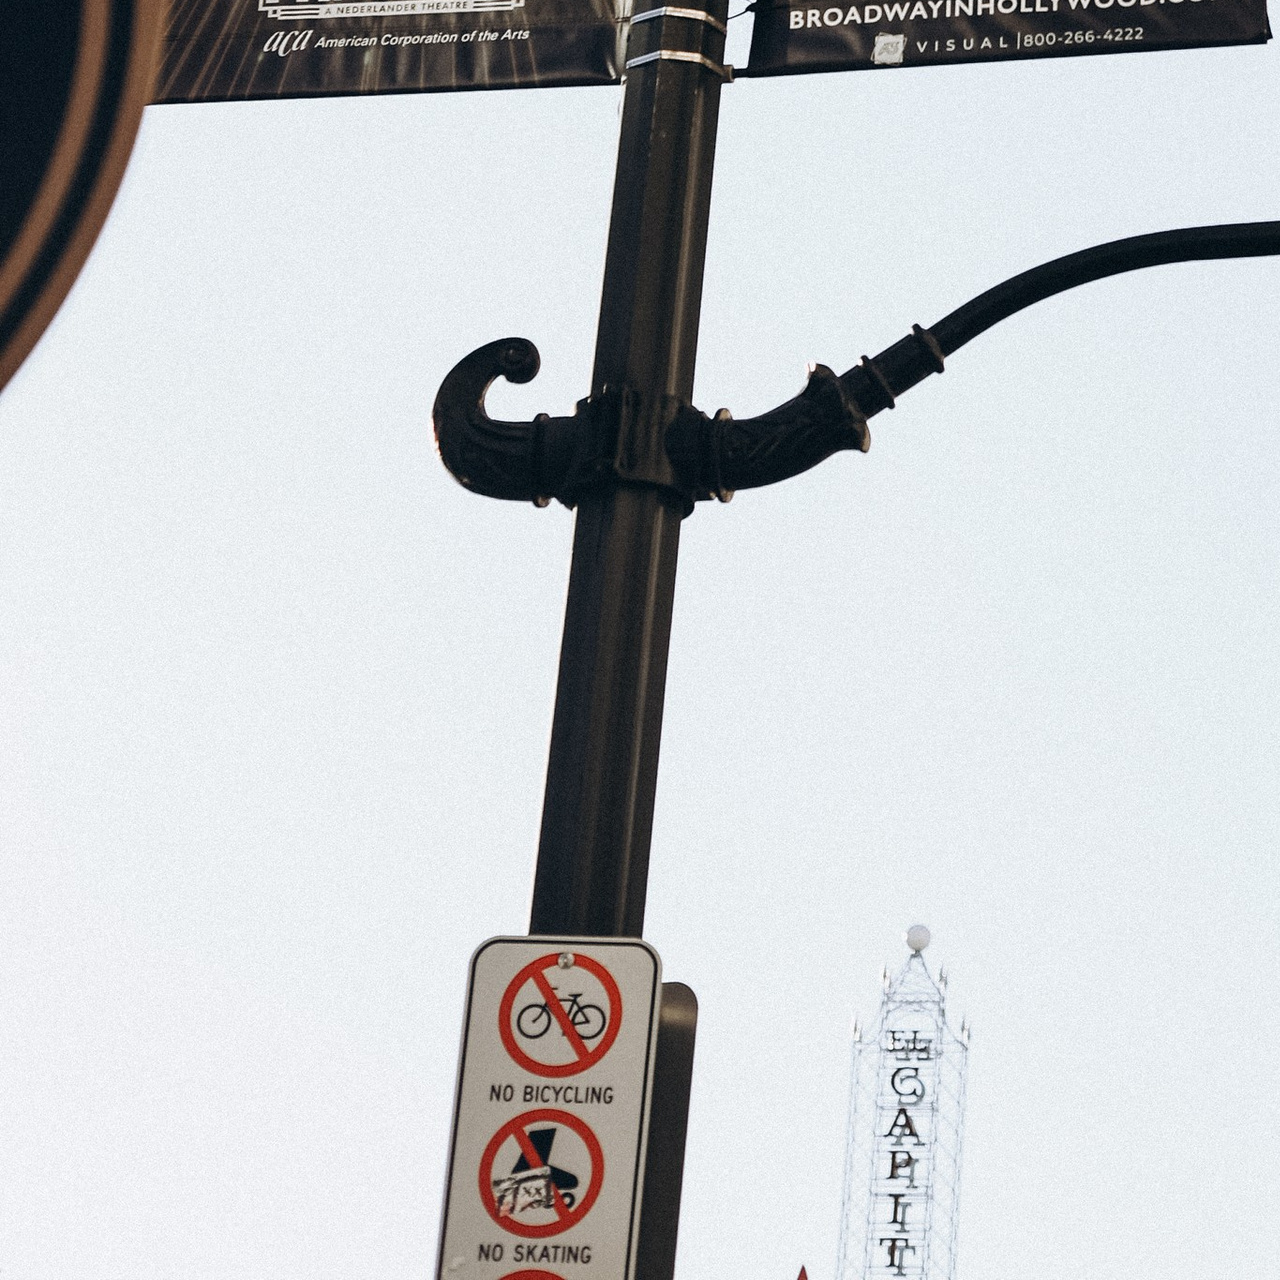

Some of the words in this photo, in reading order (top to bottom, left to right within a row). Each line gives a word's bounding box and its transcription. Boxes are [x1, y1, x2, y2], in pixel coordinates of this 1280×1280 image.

[324, 7, 332, 15] A
[336, 3, 417, 15] NEDERLANDER
[421, 0, 468, 11] THEATRE
[262, 29, 315, 58] aca
[314, 36, 377, 49] American
[380, 31, 458, 48] Corporation
[461, 31, 478, 43] of
[478, 29, 499, 42] the
[500, 28, 531, 41] Arts
[916, 36, 1009, 53] VISUAL
[489, 1084, 514, 1102] NO
[522, 1085, 615, 1105] BICYCLING
[477, 1244, 505, 1263] NO
[513, 1244, 592, 1265] SKATING
